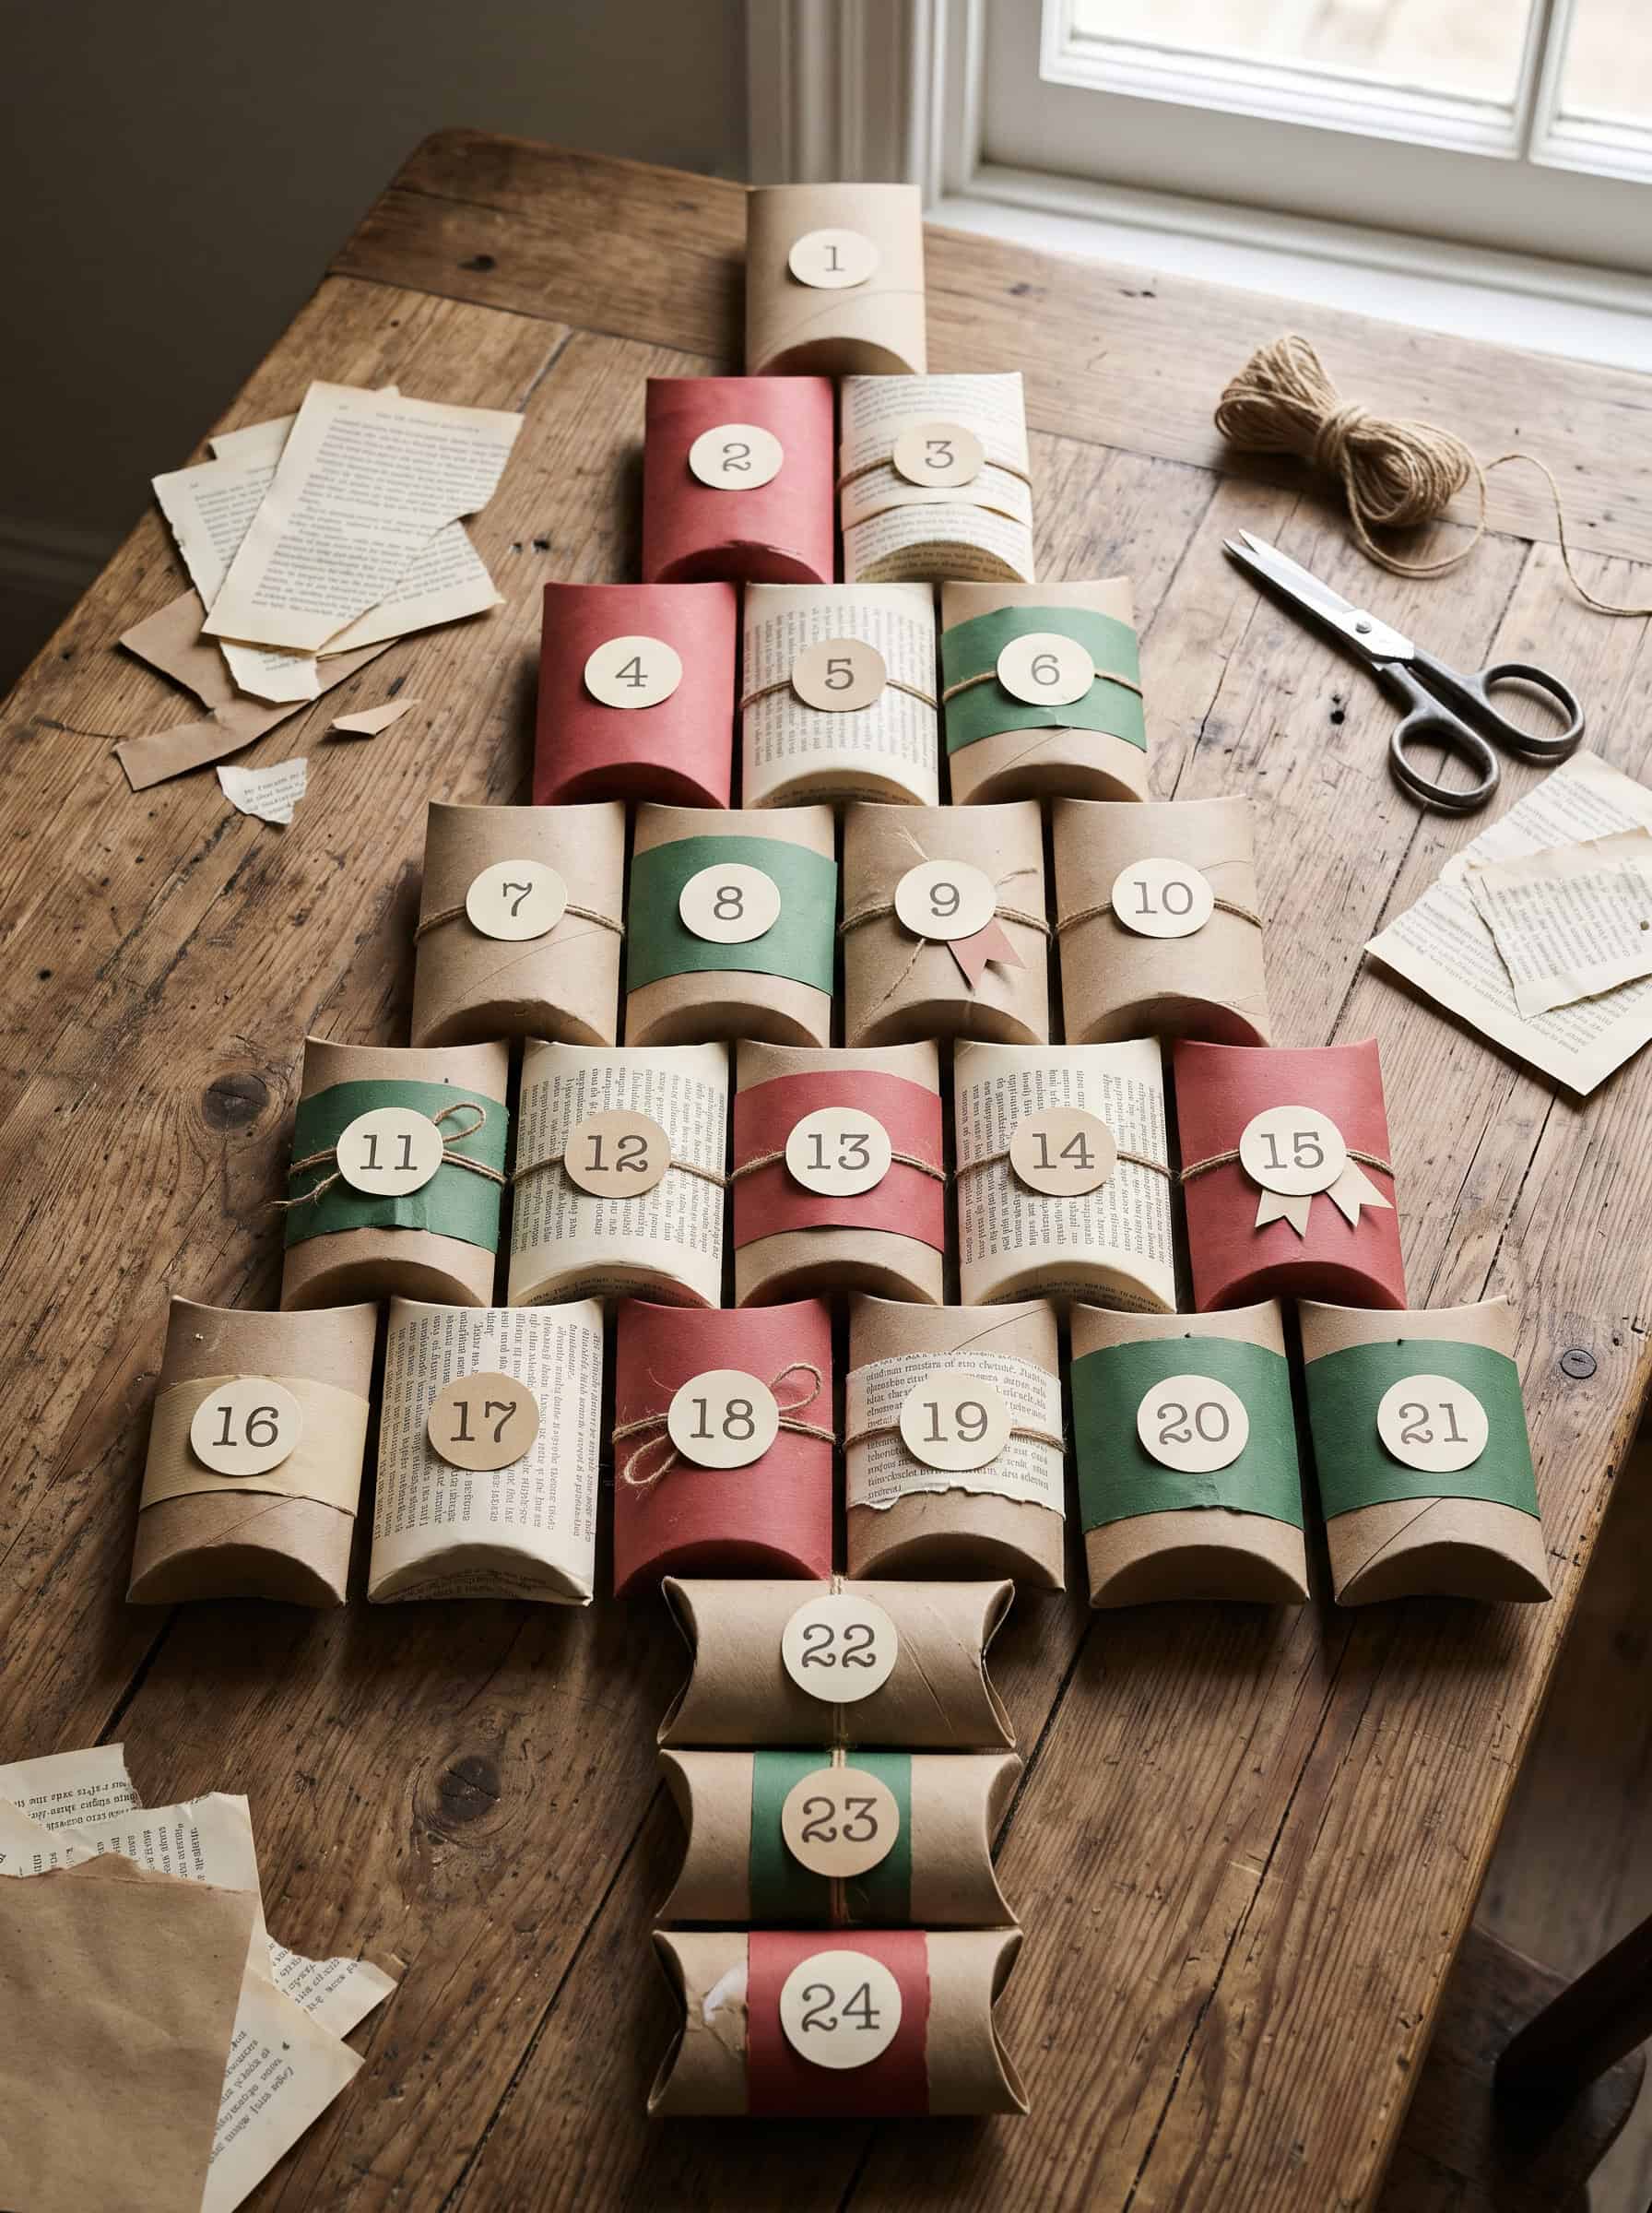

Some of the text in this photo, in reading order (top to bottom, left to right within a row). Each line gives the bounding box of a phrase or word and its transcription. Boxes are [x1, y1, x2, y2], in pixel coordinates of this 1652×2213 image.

[824, 245, 845, 272] 1
[722, 443, 751, 472] 2
[925, 440, 954, 469] 3
[615, 656, 648, 688] 4
[824, 657, 855, 691] 5
[1031, 654, 1060, 686] 6
[502, 882, 533, 917] 7
[713, 885, 744, 921] 8
[929, 882, 961, 917] 9
[1133, 881, 1194, 916] 10
[360, 1134, 418, 1171] 11
[584, 1134, 648, 1173] 12
[807, 1133, 870, 1171] 13
[1032, 1131, 1095, 1170] 14
[1260, 1131, 1325, 1169] 15
[212, 1406, 279, 1448] 16
[450, 1401, 517, 1443] 17
[690, 1398, 755, 1441] 18
[923, 1401, 988, 1442] 19
[1157, 1402, 1230, 1446] 20
[1398, 1402, 1469, 1445] 21
[801, 1623, 877, 1668] 22
[801, 1796, 879, 1844] 23
[801, 1982, 880, 2033] 24
